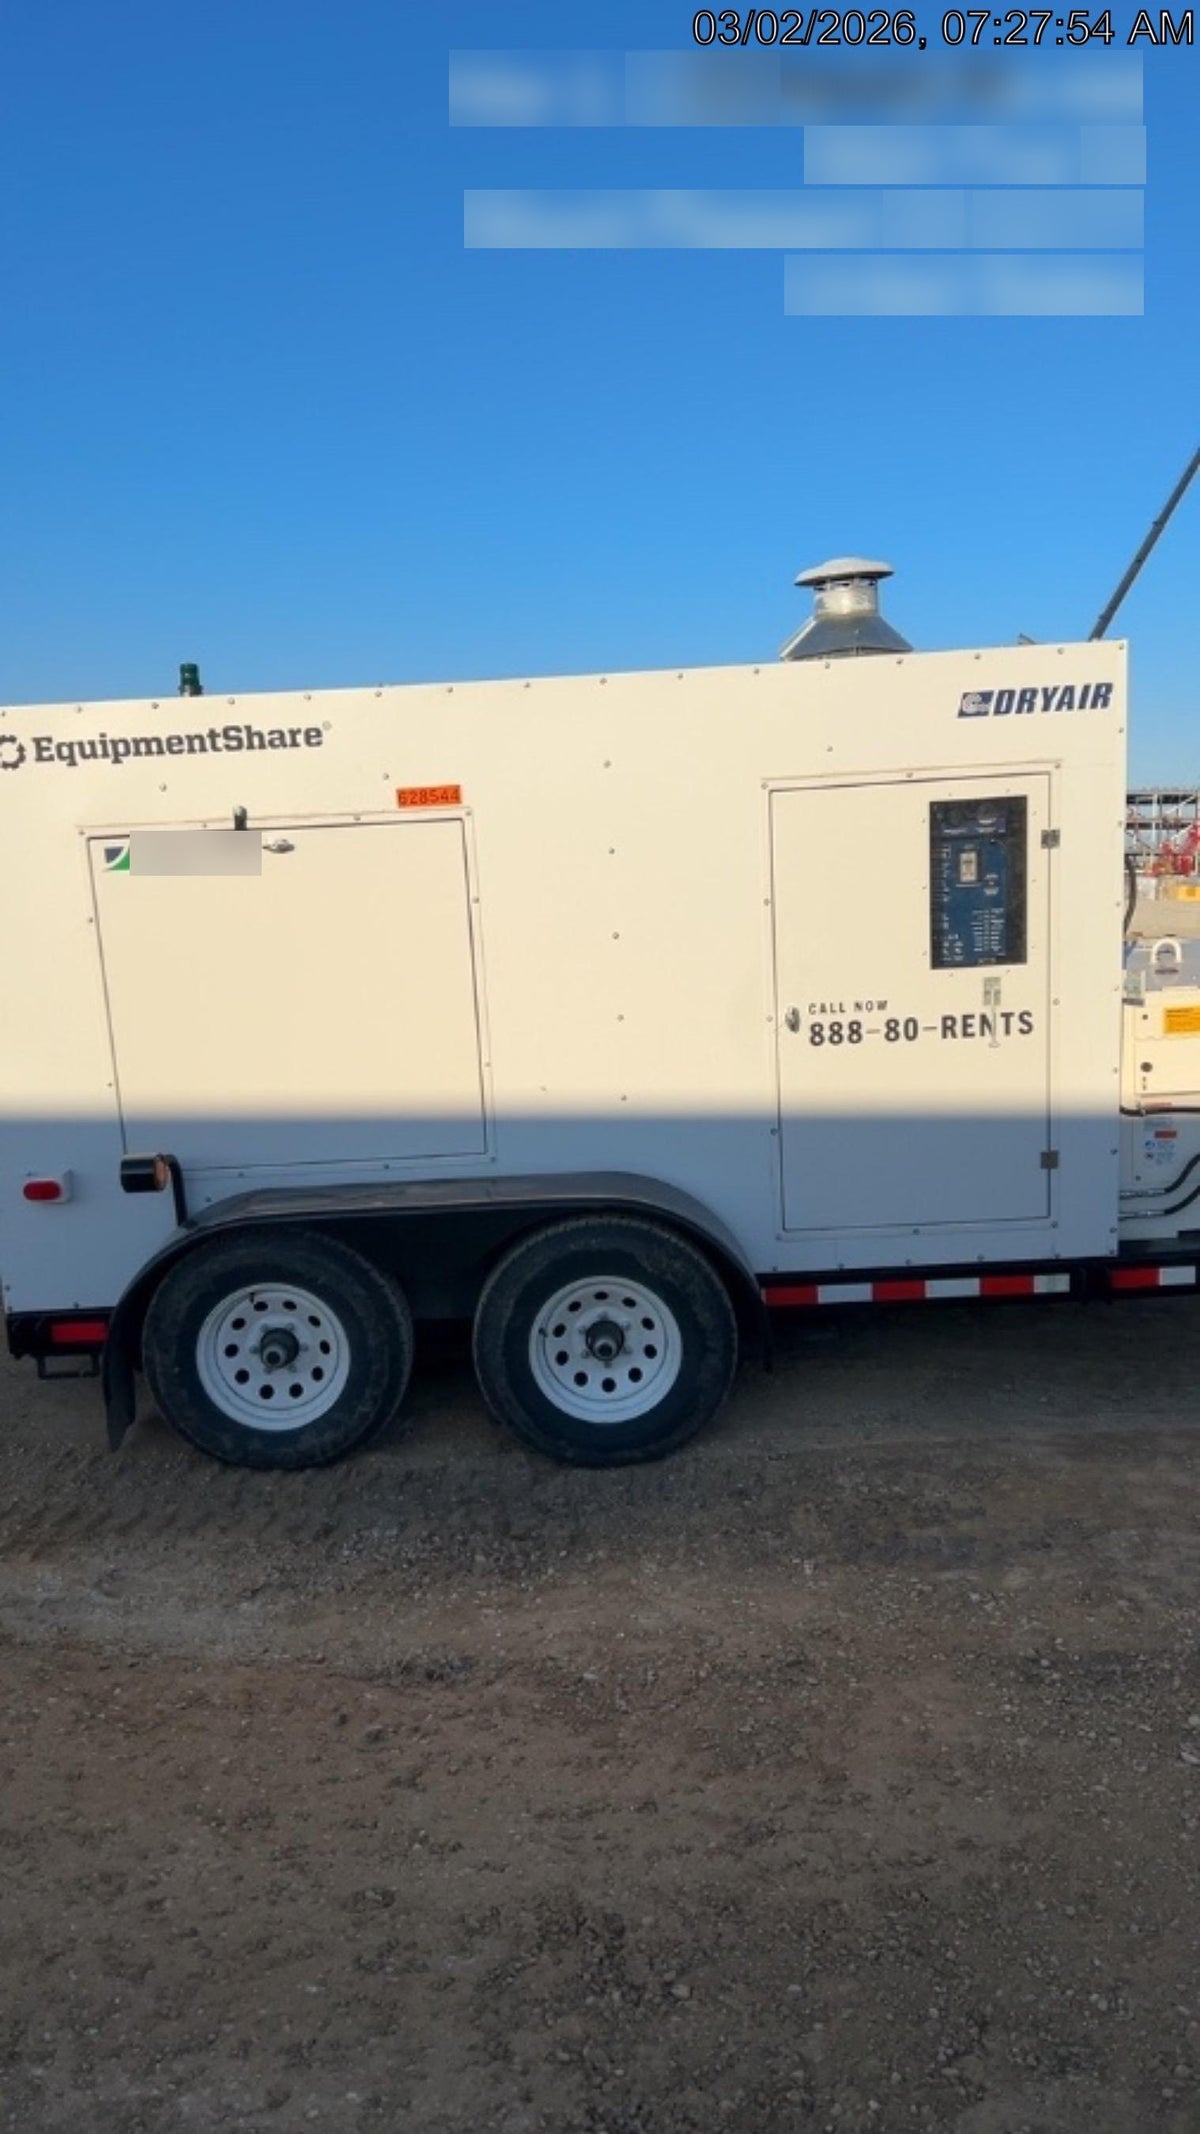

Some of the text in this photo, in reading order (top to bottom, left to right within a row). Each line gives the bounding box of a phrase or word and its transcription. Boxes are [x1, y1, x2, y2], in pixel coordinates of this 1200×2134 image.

[993, 682, 1114, 717] DRYAIR
[31, 724, 324, 767] EquipmentShare
[808, 1000, 889, 1015] CALL NOW
